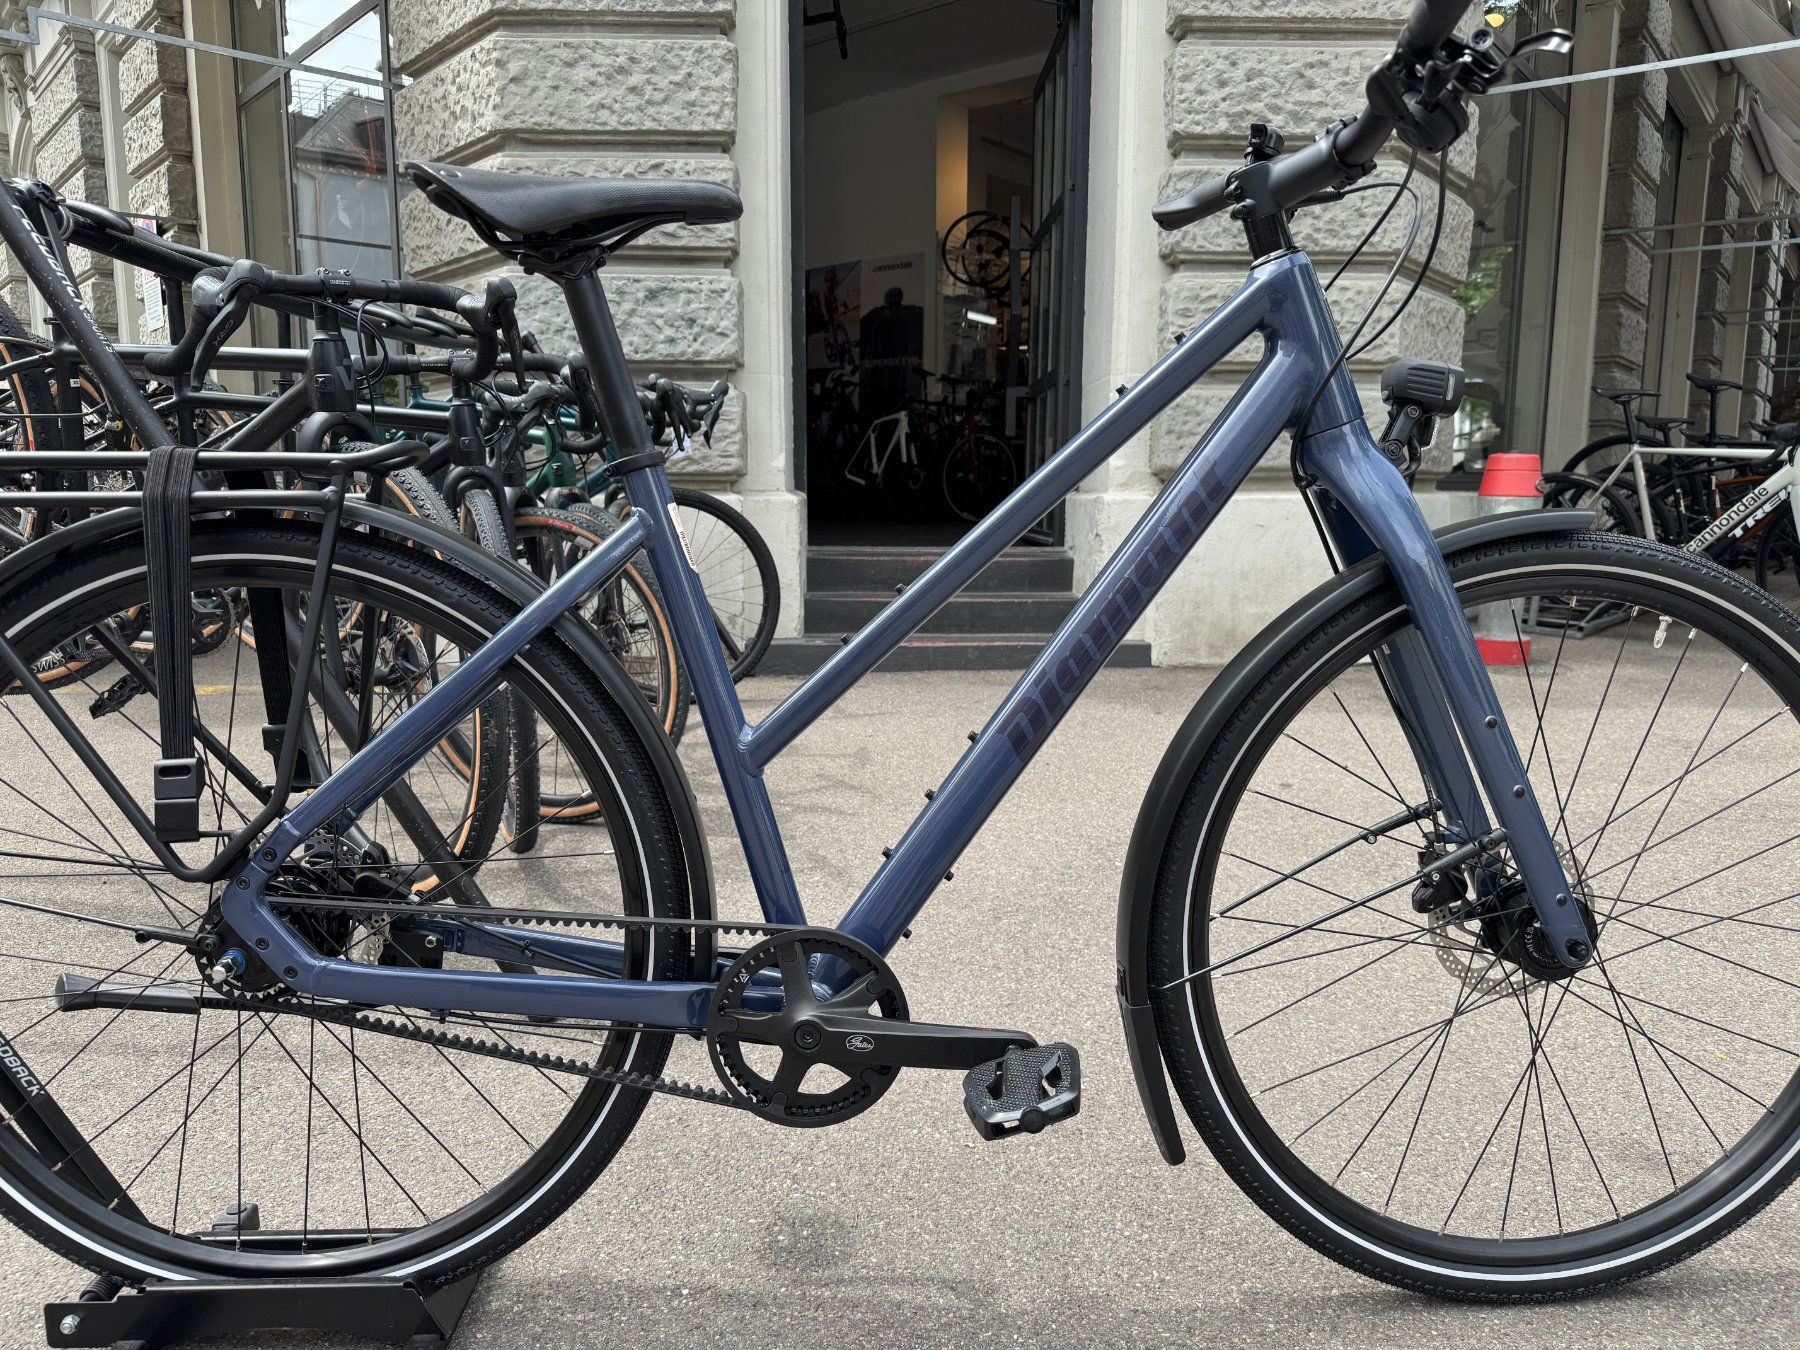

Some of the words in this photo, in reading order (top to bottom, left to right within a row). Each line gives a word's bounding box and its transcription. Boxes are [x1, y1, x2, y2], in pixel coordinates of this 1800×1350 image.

[212, 319, 234, 347] GRX
[1686, 487, 1769, 554] cannondale
[994, 458, 1232, 764] Diamant
[33, 656, 67, 673] SWISS
